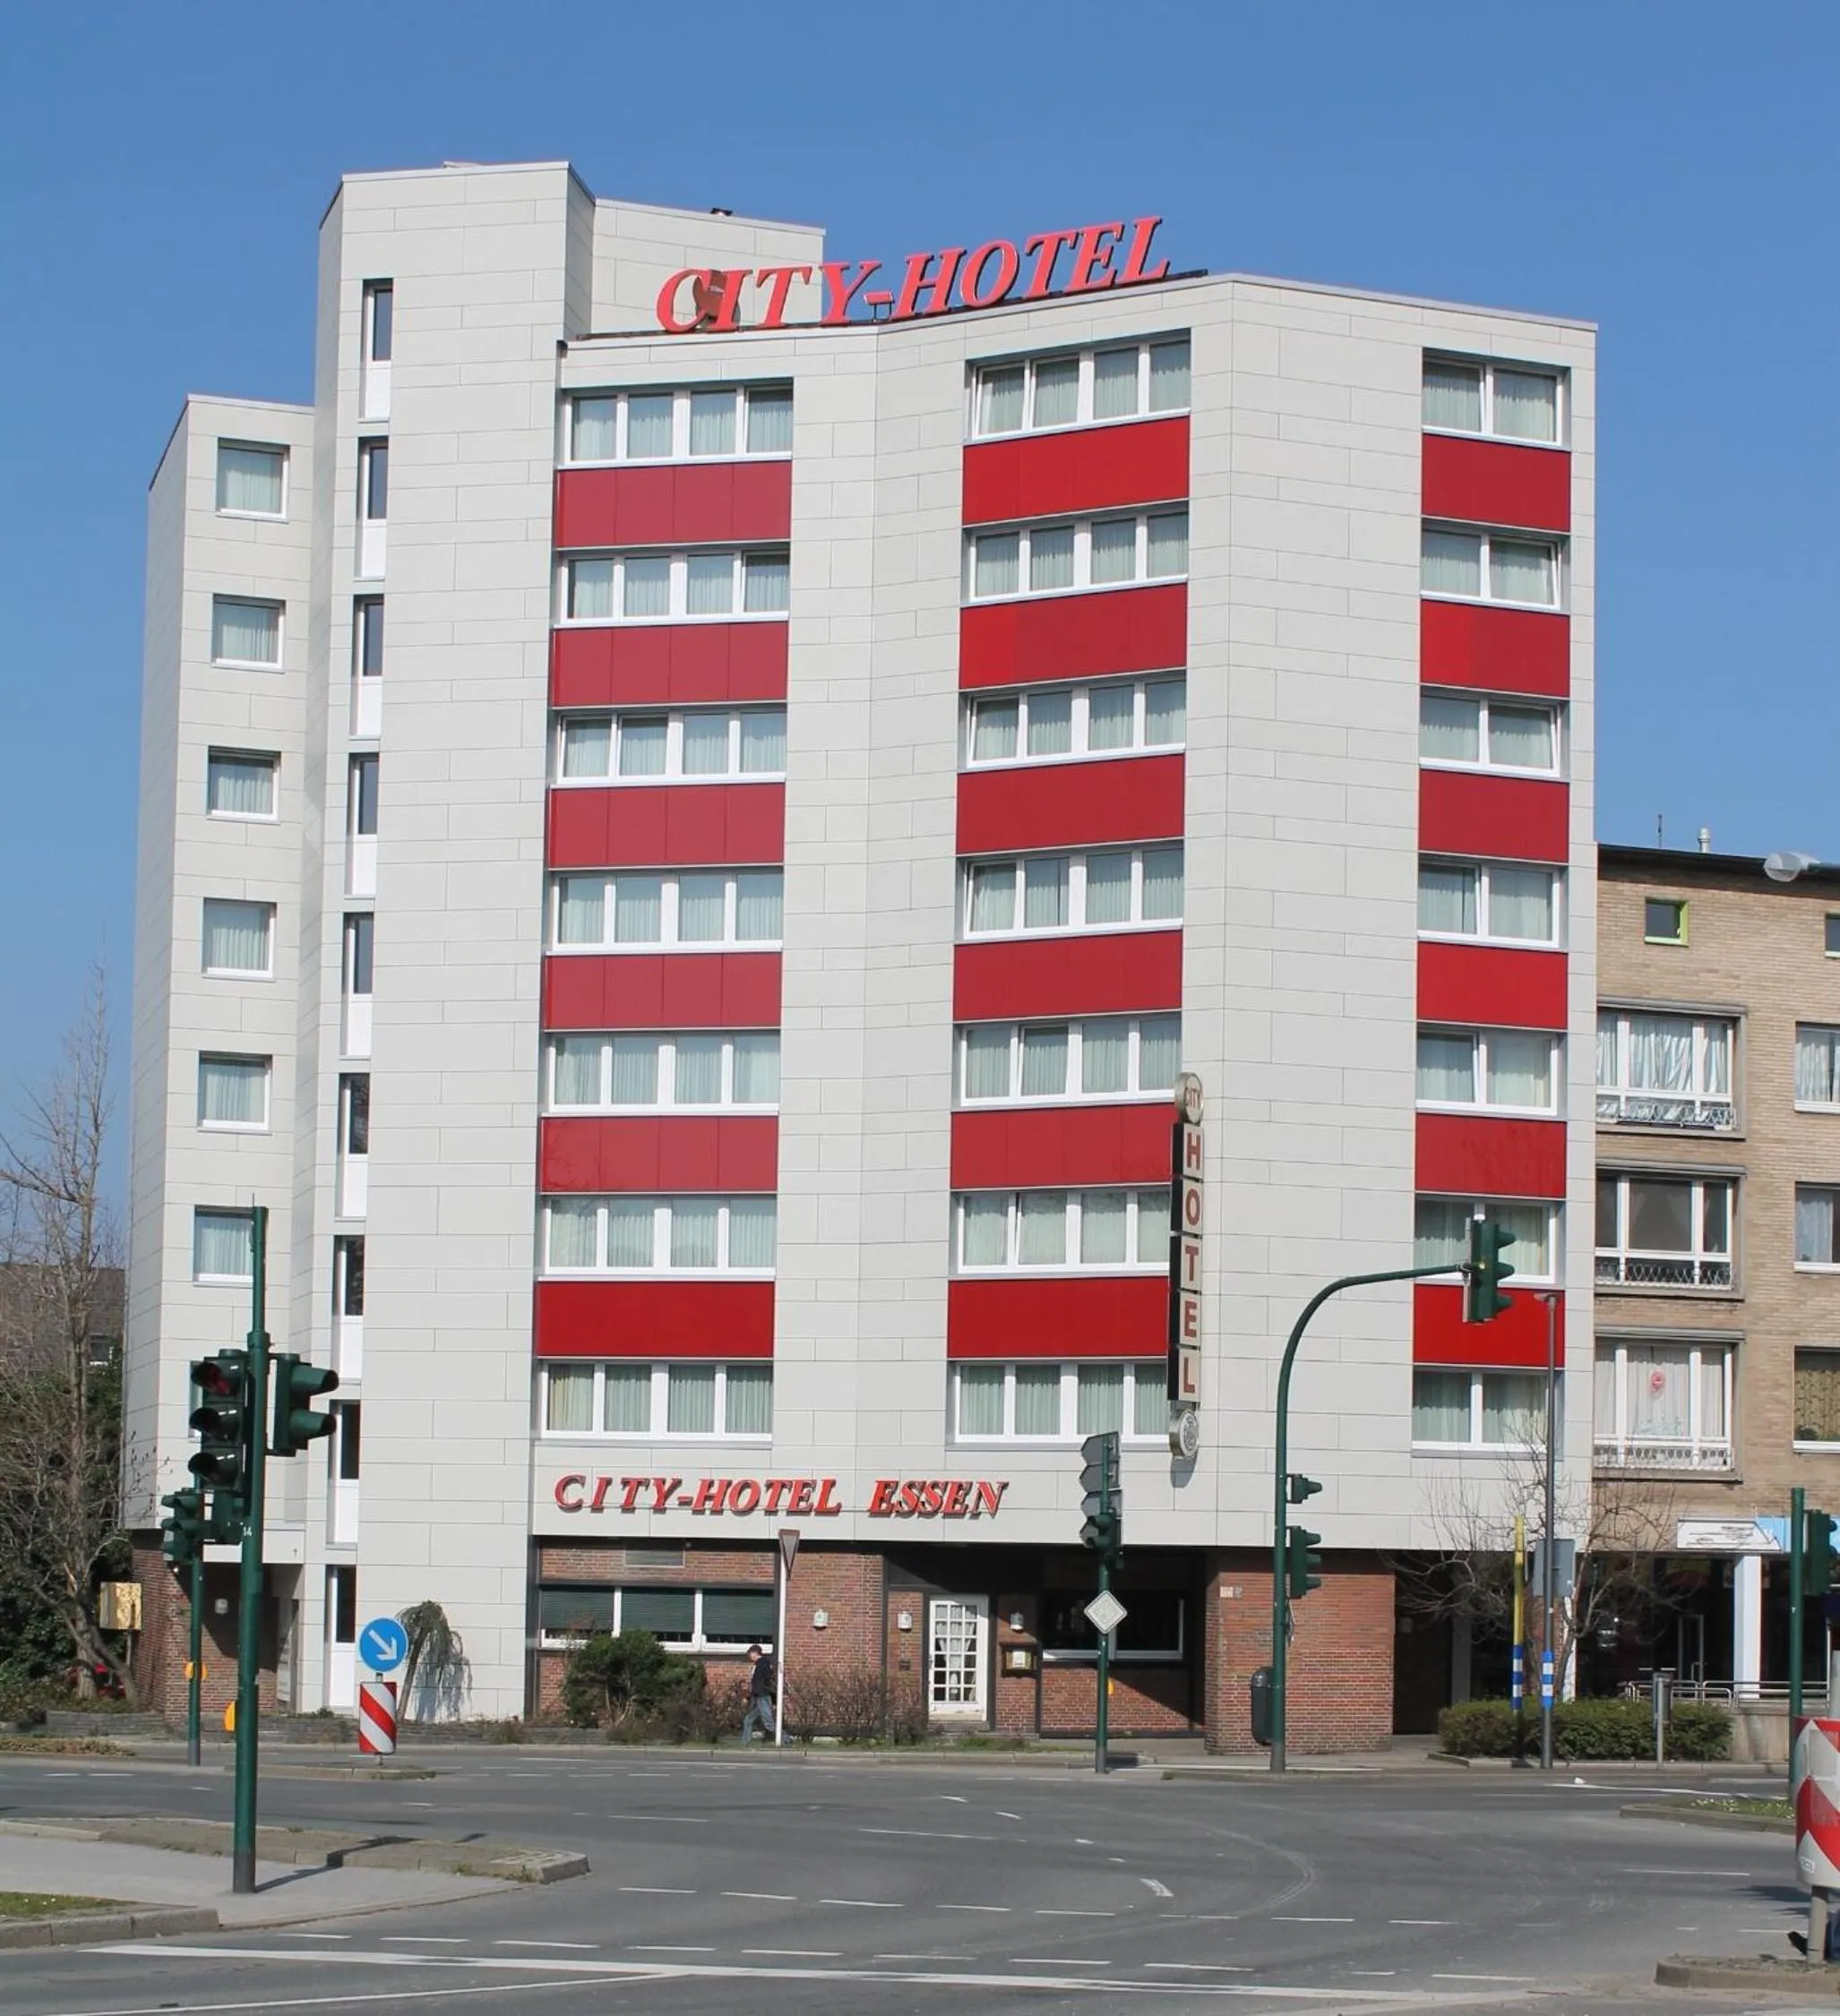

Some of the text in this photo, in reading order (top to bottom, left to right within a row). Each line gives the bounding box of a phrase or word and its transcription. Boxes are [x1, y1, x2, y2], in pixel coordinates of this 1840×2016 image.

[657, 216, 1171, 332] CITY-HOTEL
[1183, 1086, 1201, 1110] CITY
[1182, 1132, 1201, 1394] HOTEL
[555, 1474, 1010, 1519] CITY-HOTEL ESSEN
